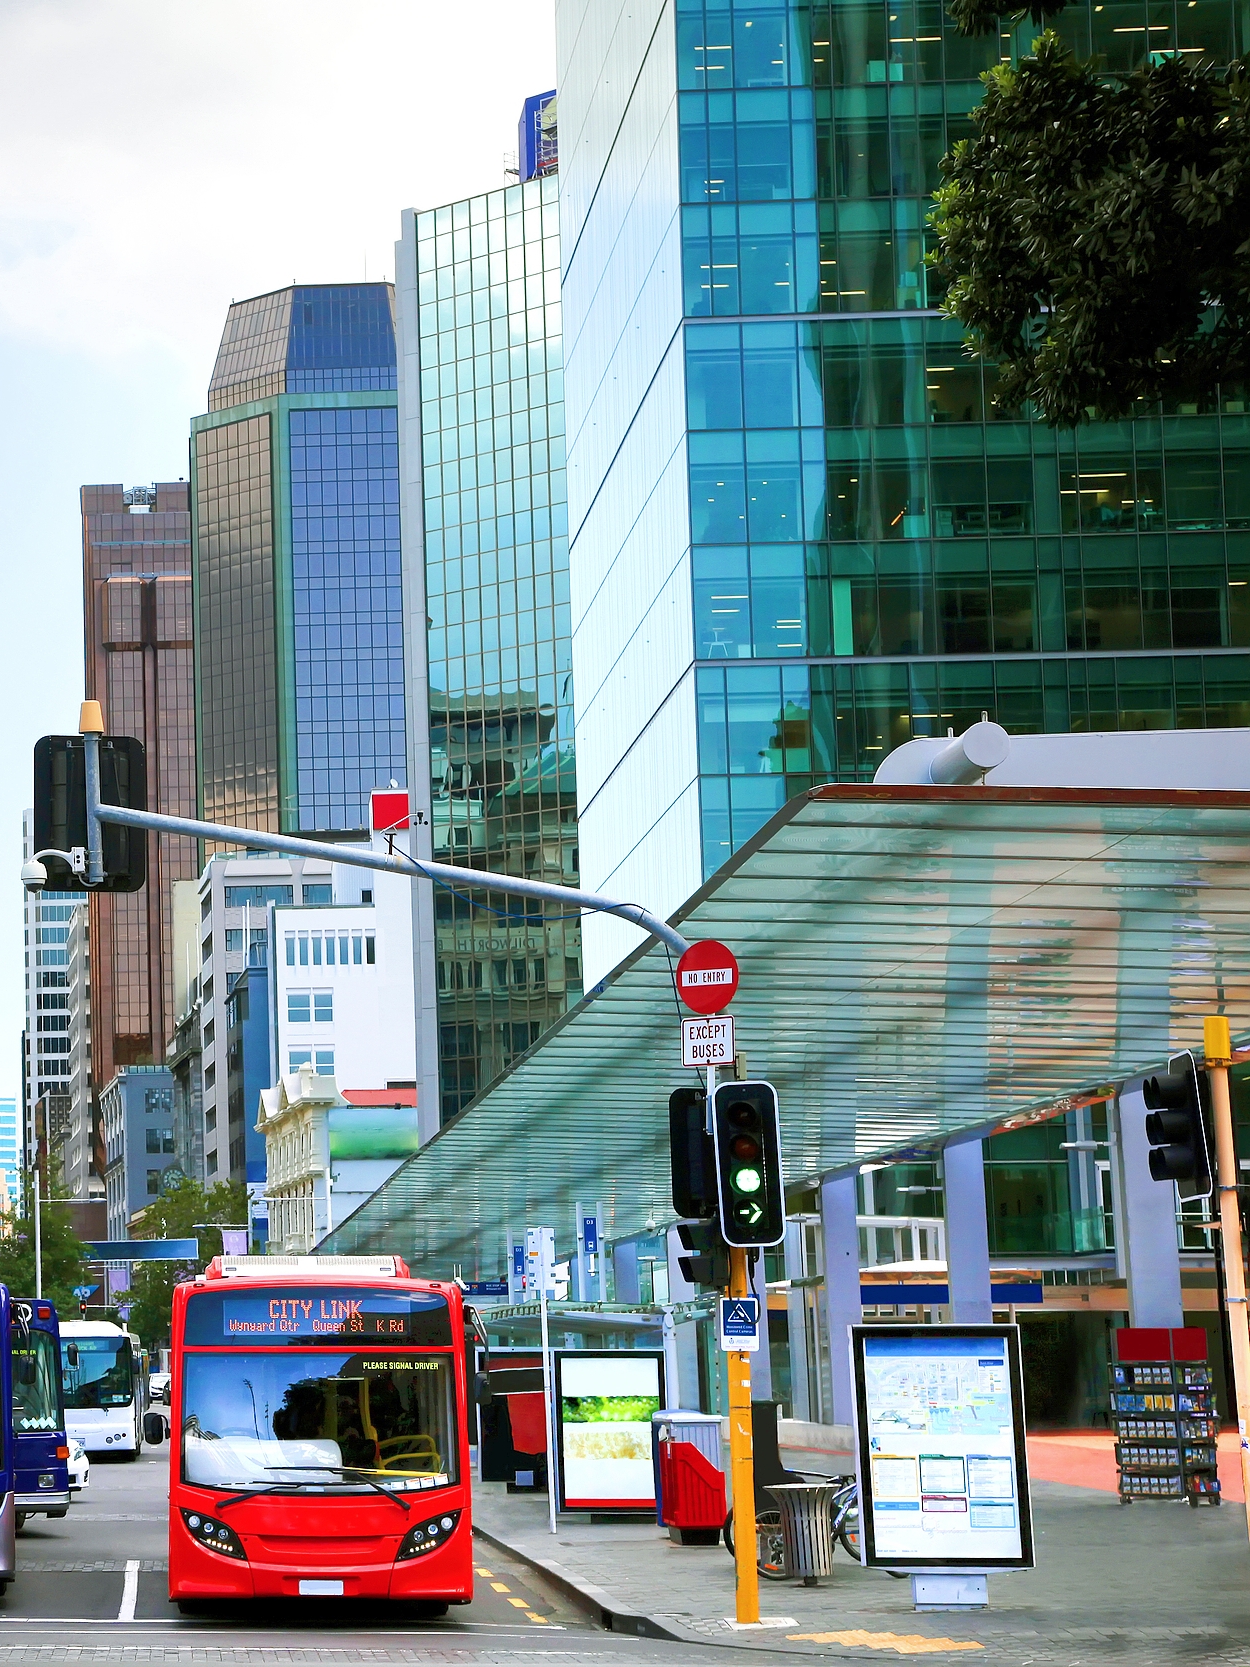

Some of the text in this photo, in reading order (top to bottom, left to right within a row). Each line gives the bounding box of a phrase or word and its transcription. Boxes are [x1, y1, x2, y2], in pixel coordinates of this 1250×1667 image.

[688, 971, 726, 984] NO ENTRY
[689, 1024, 727, 1040] EXCEPT
[692, 1043, 725, 1058] BUSES
[268, 1300, 364, 1320] CITY LINK
[229, 1319, 405, 1332] Wynyard Qtr Queen St K Rd
[362, 1361, 439, 1370] PLEASE SIGNAL DRIVER
